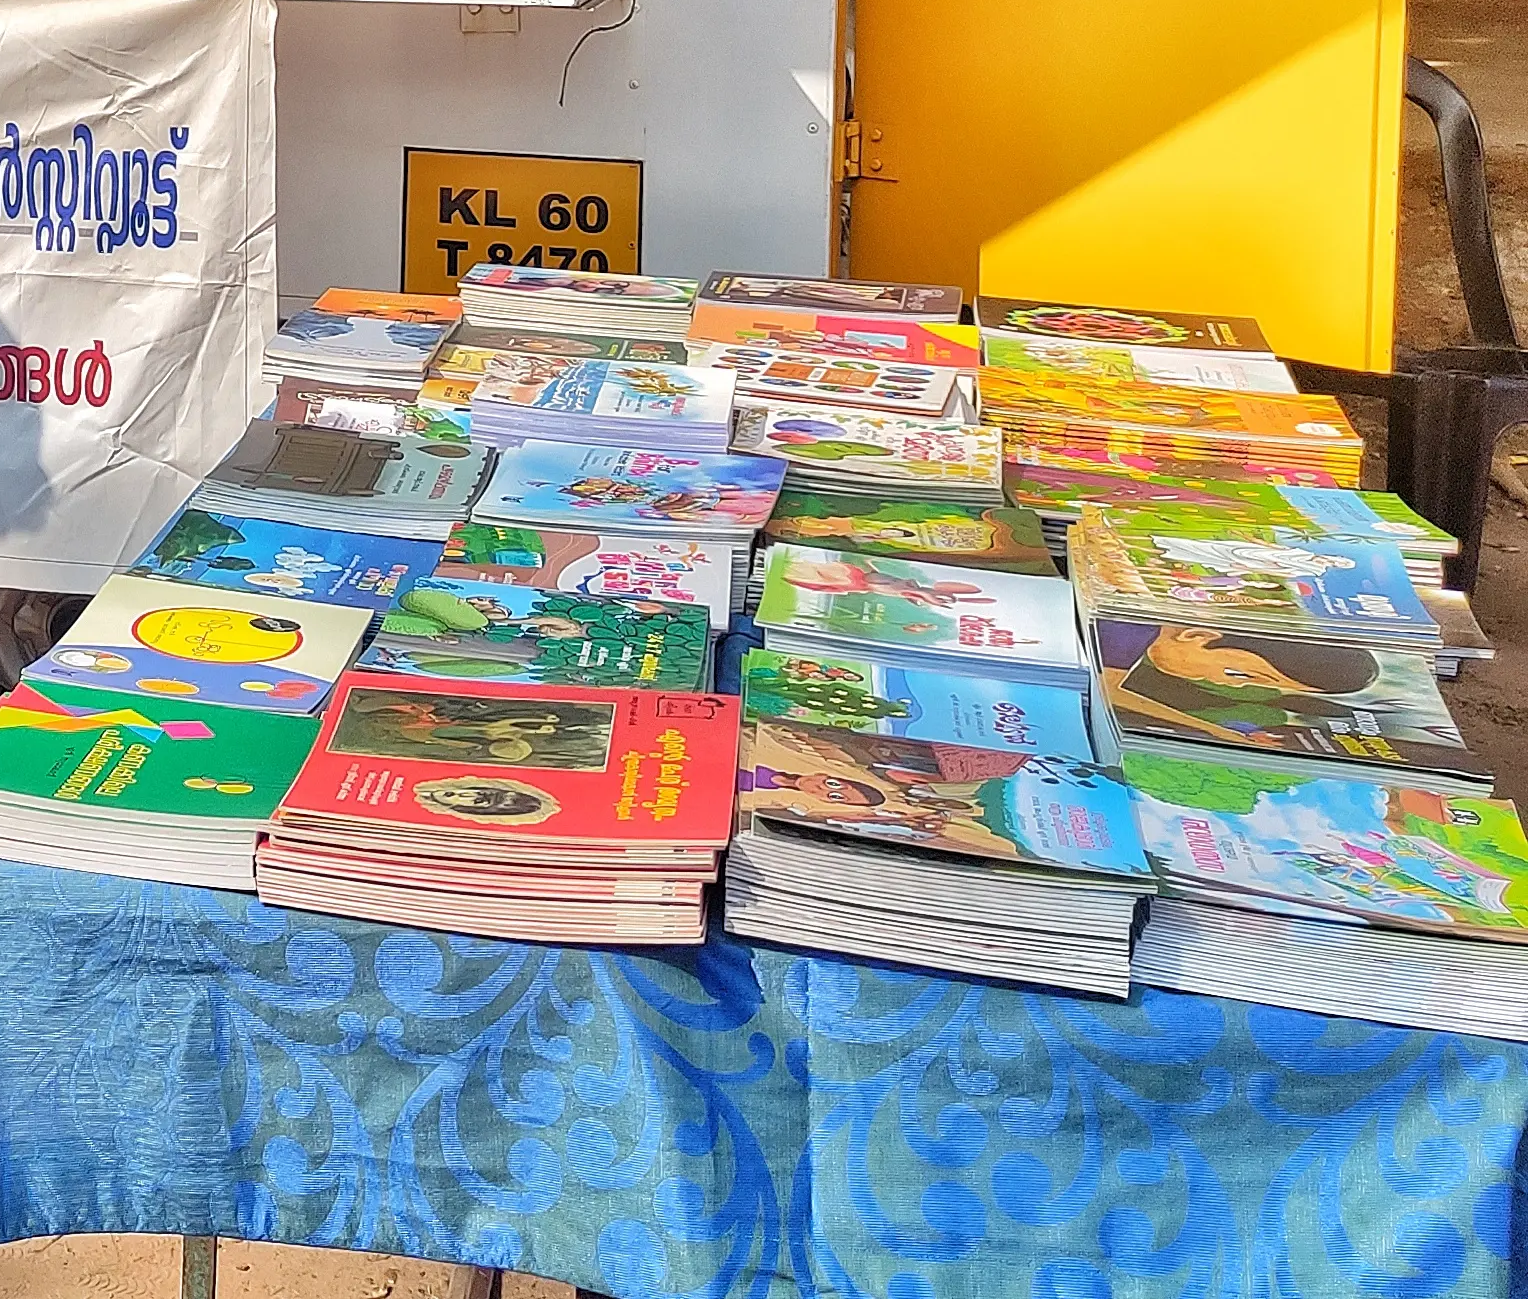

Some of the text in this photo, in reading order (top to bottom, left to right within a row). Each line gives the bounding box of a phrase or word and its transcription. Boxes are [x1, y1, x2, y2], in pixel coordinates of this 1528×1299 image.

[439, 186, 609, 234] KL 60
[437, 239, 469, 277] T
